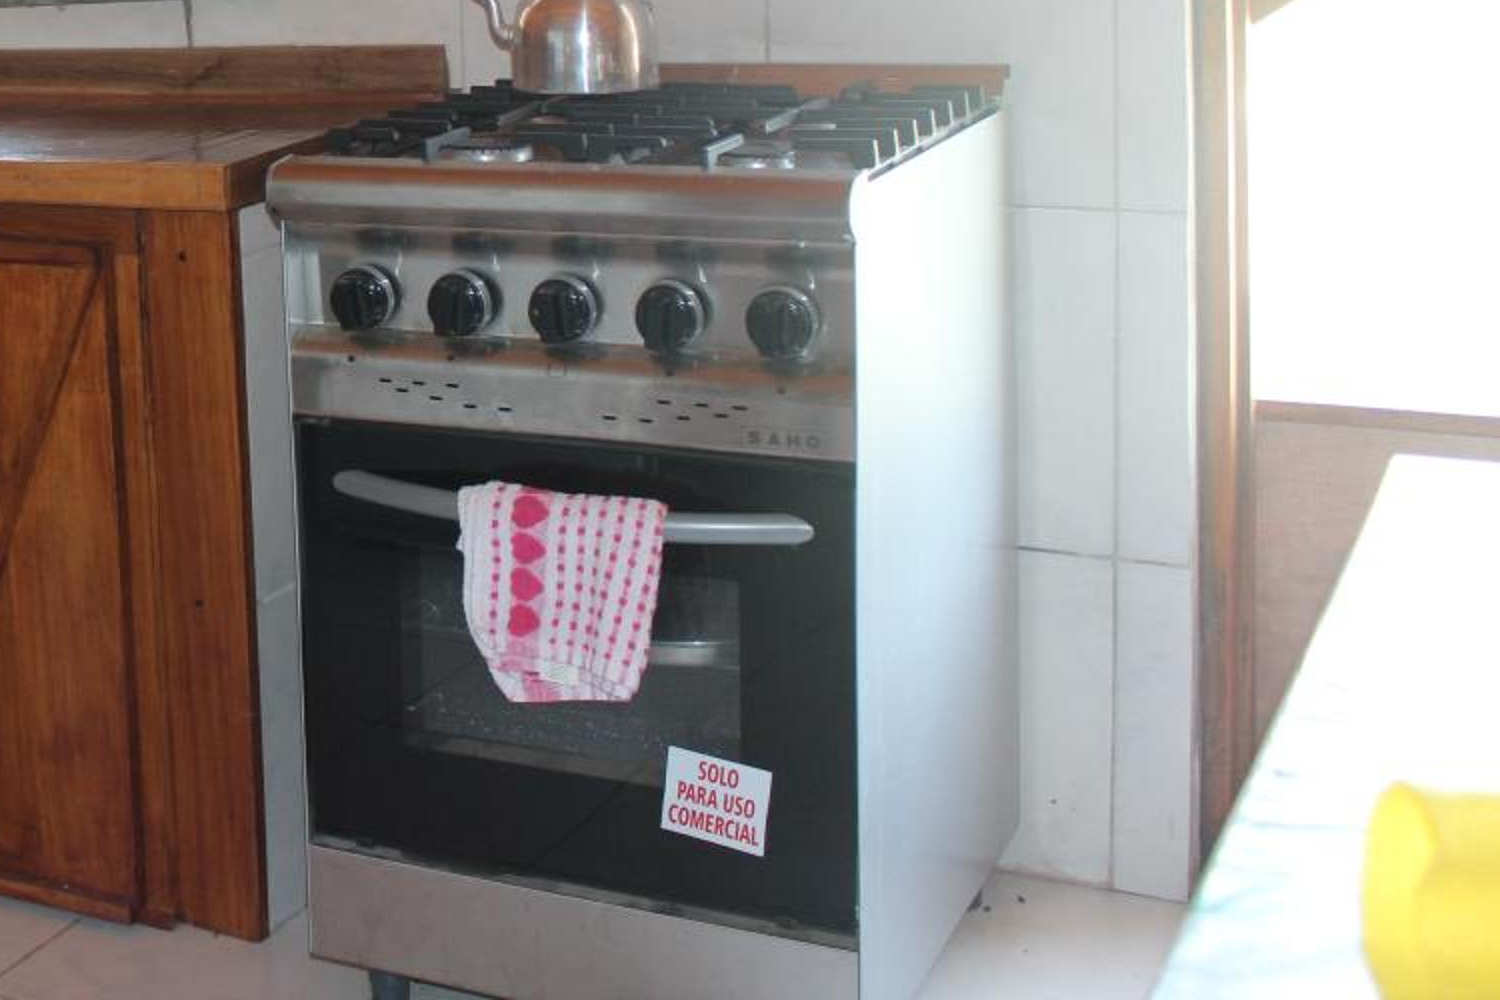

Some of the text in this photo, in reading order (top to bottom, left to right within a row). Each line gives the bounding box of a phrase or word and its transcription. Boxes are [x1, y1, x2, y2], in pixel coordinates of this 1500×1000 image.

[698, 761, 739, 789] SOLO
[677, 781, 755, 819] PARA USO
[668, 804, 759, 846] COMERCIAL
